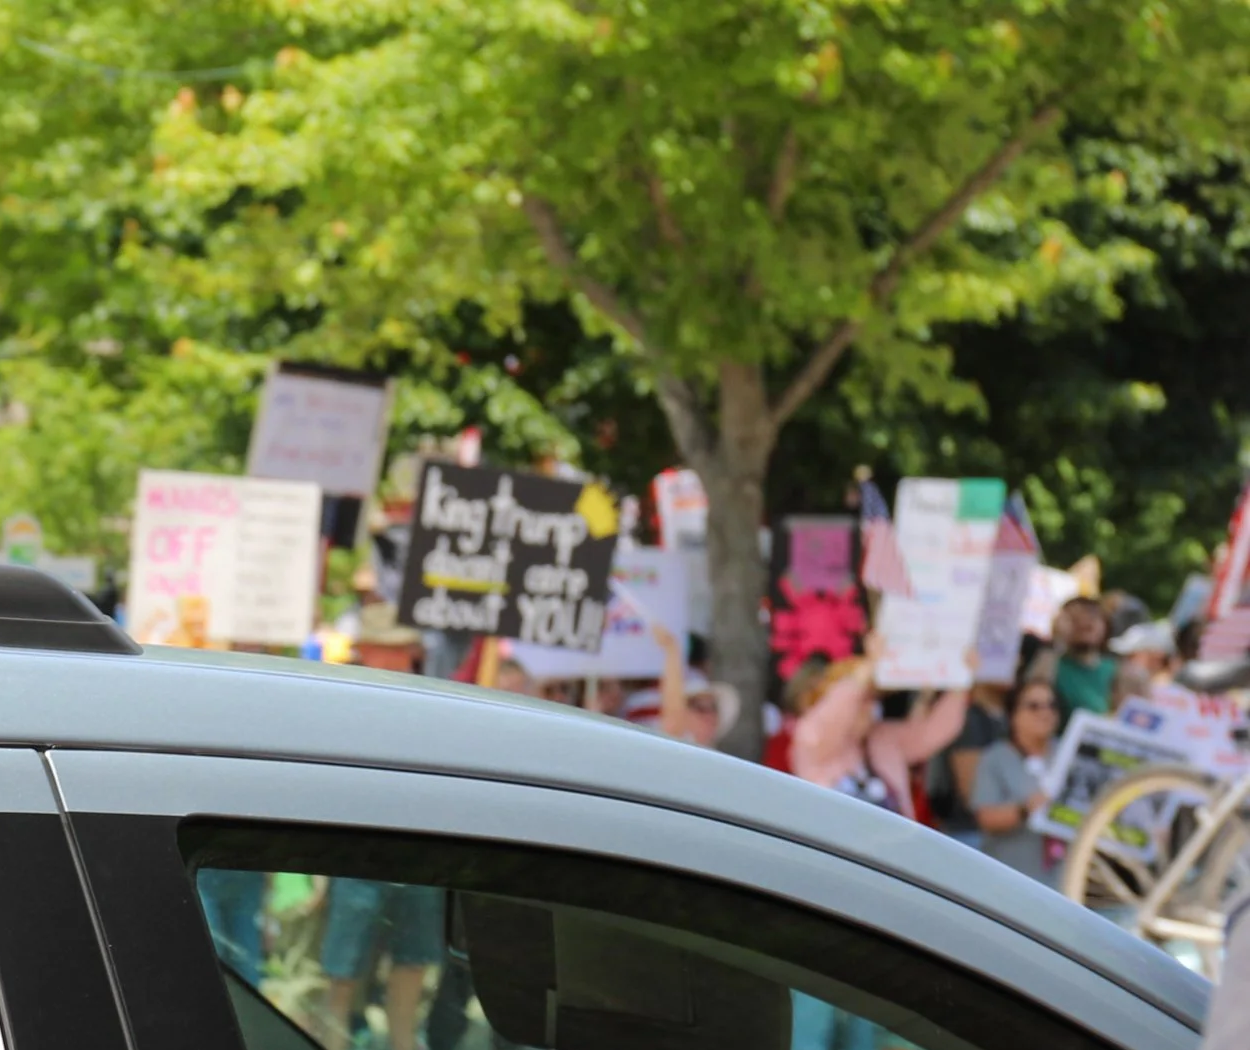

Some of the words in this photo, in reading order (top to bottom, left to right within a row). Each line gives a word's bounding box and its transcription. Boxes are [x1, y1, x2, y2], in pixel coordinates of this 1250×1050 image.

[420, 465, 488, 554] king
[490, 473, 588, 566] trump
[146, 525, 218, 566] OFF
[412, 586, 507, 632] about
